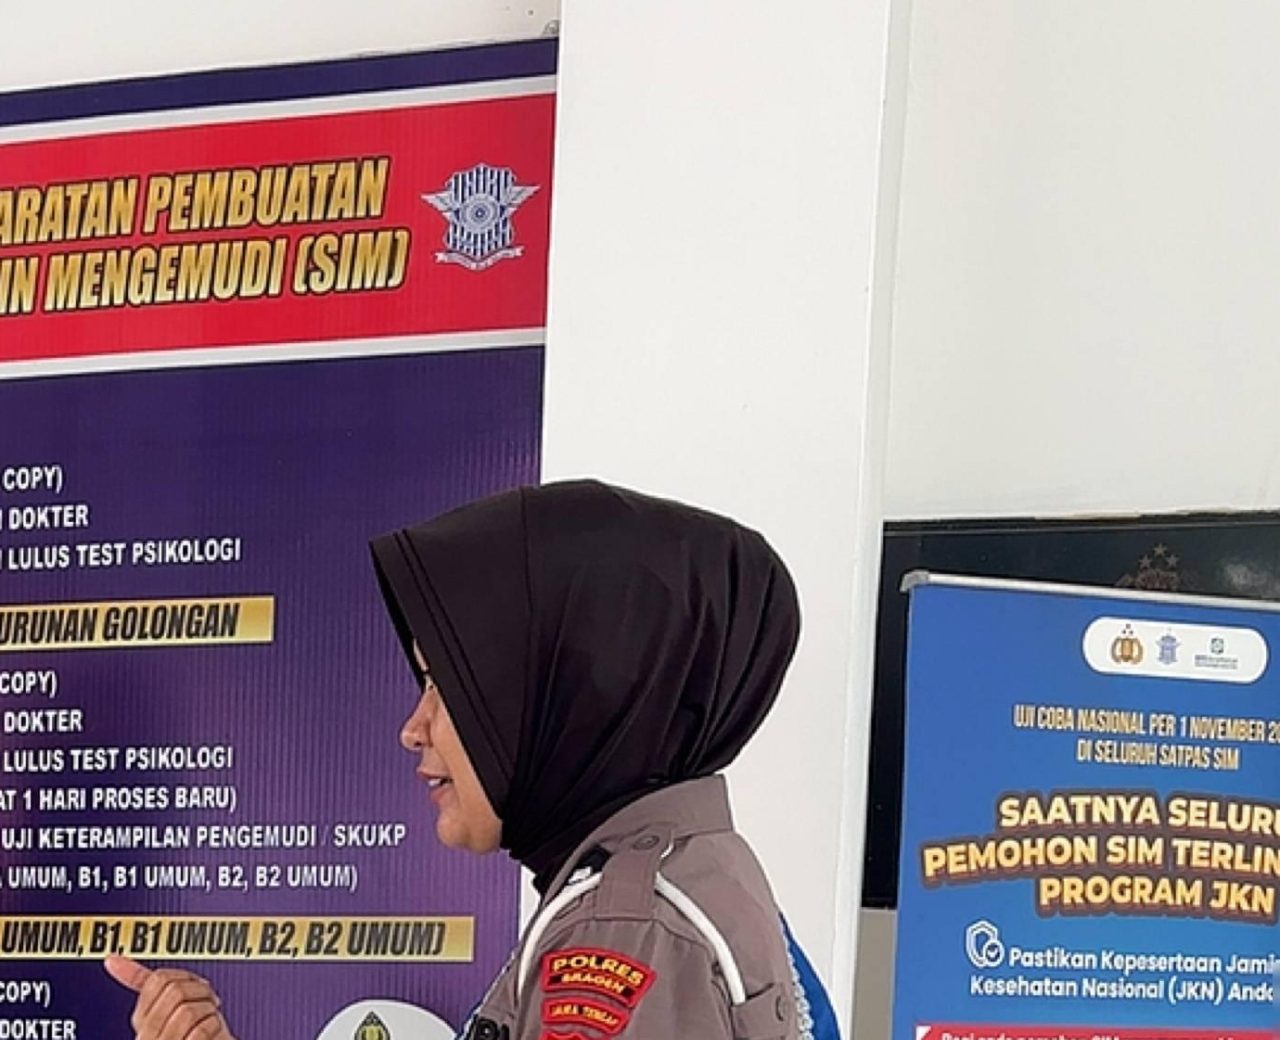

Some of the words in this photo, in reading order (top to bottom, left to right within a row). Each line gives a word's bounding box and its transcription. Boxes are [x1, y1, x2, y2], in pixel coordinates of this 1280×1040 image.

[143, 157, 391, 234] PEMBUATAN
[44, 235, 284, 312] MENGEMUDI
[291, 227, 412, 295] (SIM)
[3, 466, 63, 494] COPY)
[8, 504, 89, 530] DOKTER
[8, 544, 70, 570] LULUS
[75, 542, 127, 567] TEST
[132, 537, 241, 564] PSIKOLOGI
[102, 602, 241, 641] GOLONGAN
[4, 709, 82, 733] DOKTER
[1037, 706, 1075, 731] COBA
[1077, 708, 1147, 735] NASIONAL
[1149, 713, 1177, 737] PER
[1180, 715, 1187, 738] 1
[1189, 716, 1266, 742] NOVEMBER
[3, 749, 65, 772] LULUS
[70, 747, 120, 770] TEST
[125, 746, 233, 770] PSIKOLOGI
[1077, 739, 1093, 762] DI
[1094, 739, 1158, 765] SELURUH
[1159, 743, 1211, 769] SATPAS
[1213, 746, 1239, 770] SIM
[23, 789, 32, 810] 1
[39, 788, 86, 810] HARI
[92, 786, 169, 810] PROSES
[175, 786, 237, 813] BARU)
[999, 795, 1160, 828] SAATNYA
[1, 828, 32, 850] UJI
[39, 825, 191, 849] KETERAMPILAN
[196, 825, 317, 849] PENGEMUDI
[333, 823, 406, 847] SKUKP
[923, 835, 1098, 878] PEMOHON
[1106, 835, 1165, 865] SIM
[8, 866, 72, 892] UMUM,
[78, 866, 108, 892] B1,
[114, 865, 136, 888] B1
[144, 865, 211, 892] UMUM,
[218, 865, 249, 892] B2,
[255, 864, 282, 887] B2
[287, 865, 358, 892] UMUM)
[1039, 876, 1203, 907] PROGRAM
[1209, 882, 1275, 914] JKN
[1, 920, 84, 957] UMUM,
[89, 920, 125, 956] B1,
[129, 921, 163, 954] B1
[165, 921, 253, 957] UMUM,
[258, 921, 299, 957] B2,
[304, 921, 343, 956] B2
[346, 921, 446, 956] UMUM)
[553, 955, 645, 987] POLRES
[1009, 947, 1098, 969] Pastikan
[1101, 950, 1222, 975] Kepesertaan
[970, 975, 1079, 997] Kesehatan
[1081, 977, 1165, 999] Nasional
[1168, 977, 1224, 1005] (JKN)
